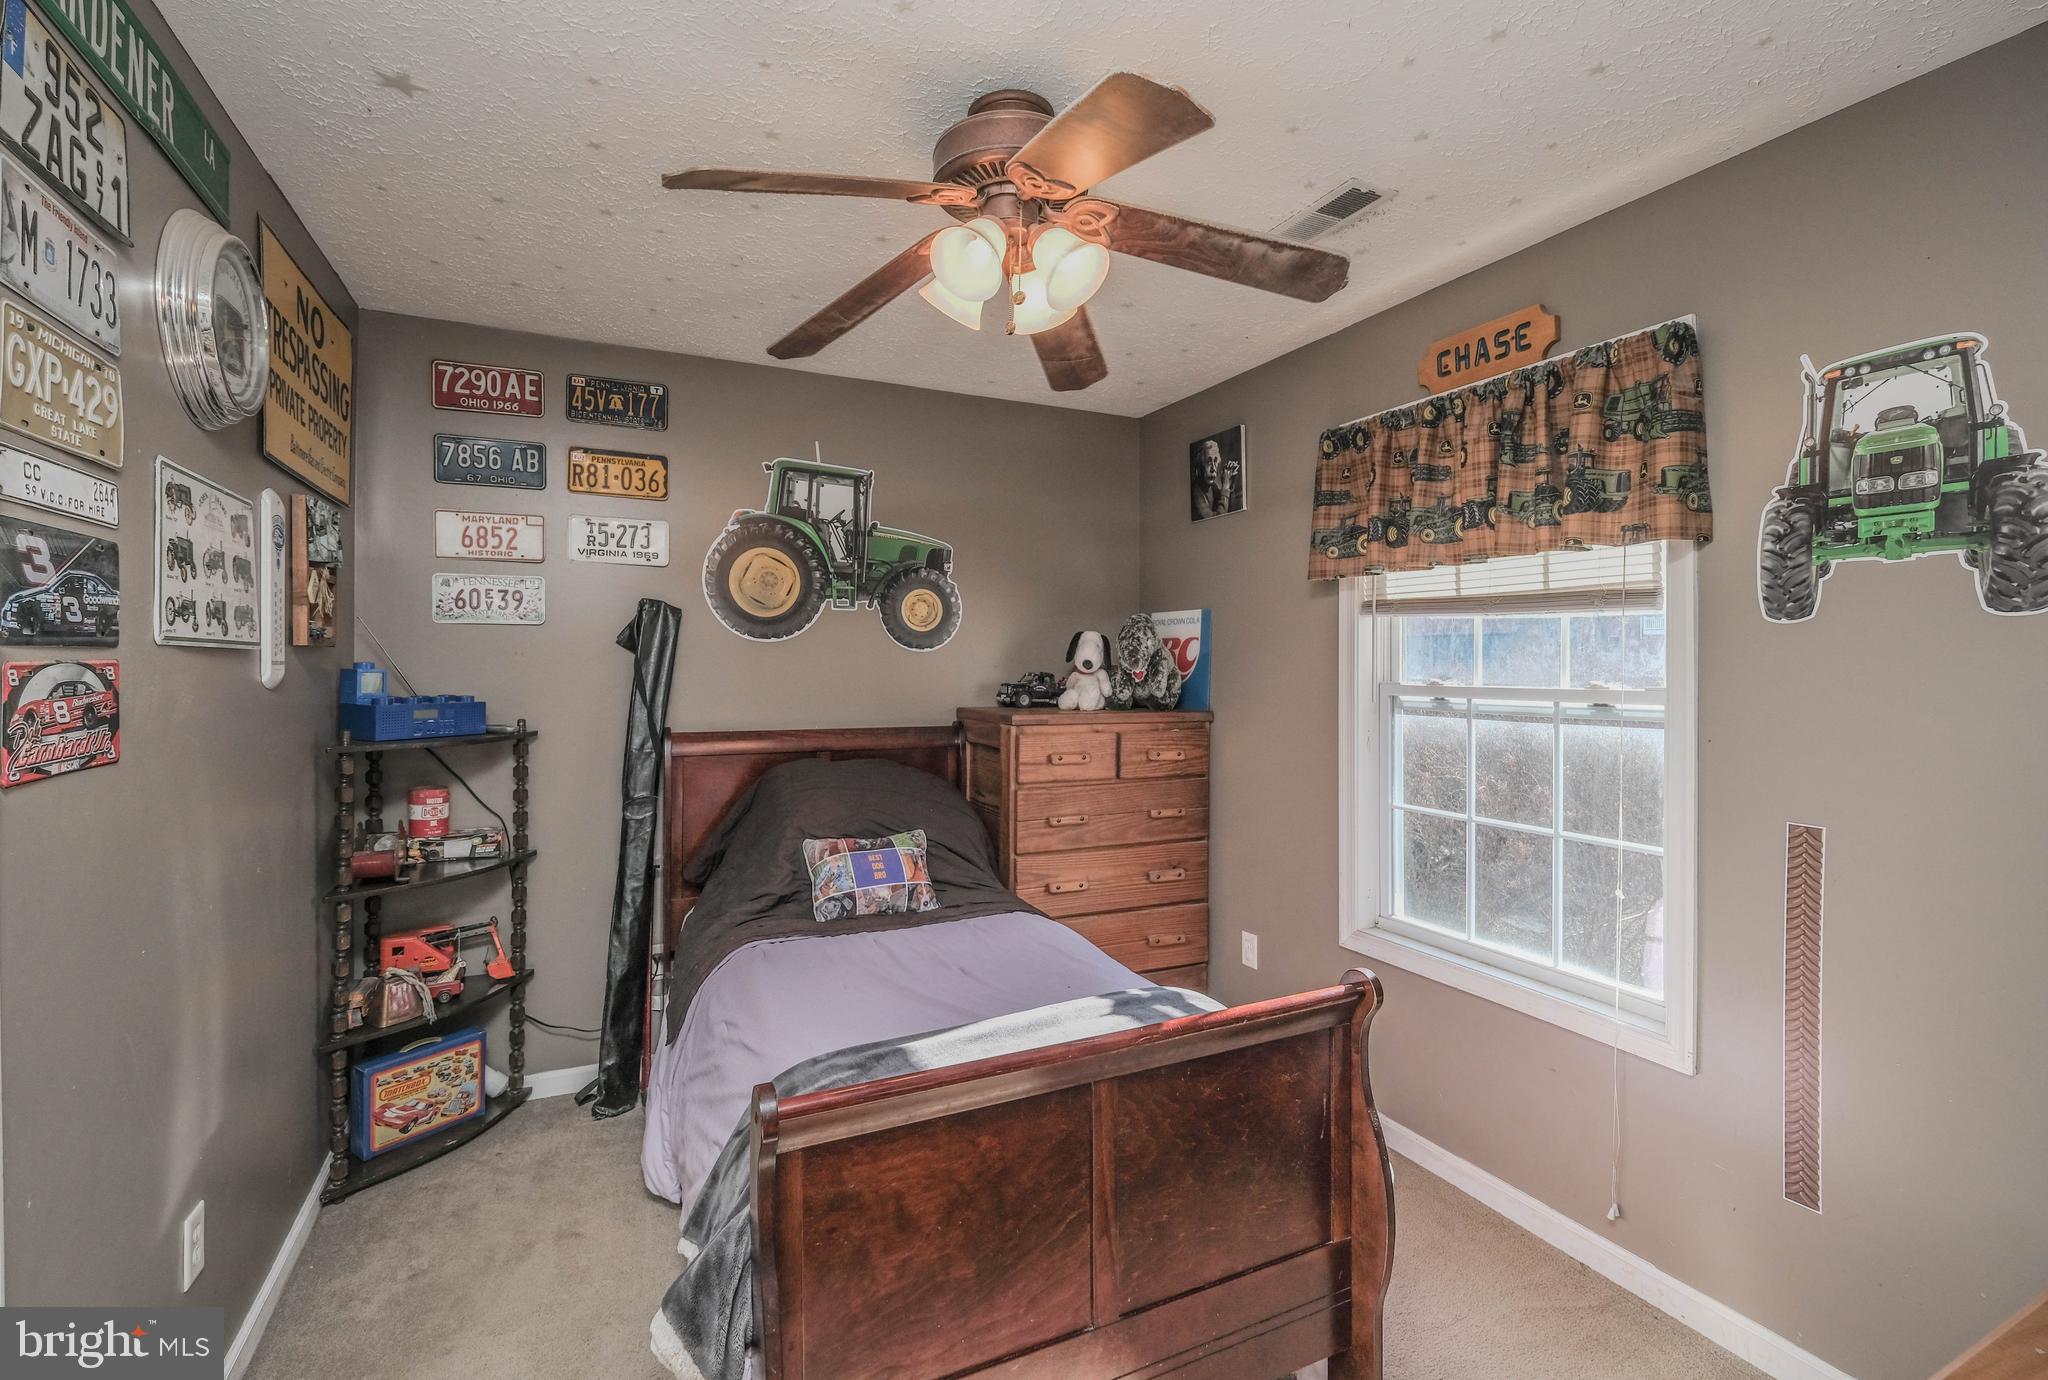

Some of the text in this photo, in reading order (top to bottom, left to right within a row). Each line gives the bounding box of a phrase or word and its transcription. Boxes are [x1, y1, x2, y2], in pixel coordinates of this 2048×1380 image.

[45, 38, 104, 155] 952
[59, 0, 216, 171] DENER LA
[21, 84, 88, 201] ZAG
[41, 194, 52, 212] The
[21, 200, 38, 275] M
[66, 239, 117, 329] 1733
[296, 285, 325, 350] NO
[9, 311, 25, 329] 19
[38, 328, 95, 371] MICHIGAN
[1437, 321, 1532, 377] CHASE
[266, 296, 350, 422] TRESPASSING
[269, 368, 348, 459] PRIVATE PROPERTY
[460, 397, 519, 411] OHIO 1966
[570, 410, 622, 422] BICENTENNIAL
[572, 387, 660, 418] 45V 177
[33, 403, 97, 439] GREAT LAKE
[51, 425, 82, 447] STATE
[441, 441, 539, 473] 7856 AB
[591, 455, 647, 467] PENNSYLVANIA
[23, 461, 115, 508] CC 2644
[467, 474, 516, 484] 67 OHIO
[25, 484, 36, 496] 59
[89, 504, 105, 517] HIRE
[462, 515, 519, 525] MARYLAND
[461, 525, 518, 551] 6852
[16, 533, 56, 587] 3
[577, 547, 659, 560] VIRGINIA 1969
[460, 577, 519, 588] TENNESSEE
[62, 596, 83, 622] 3
[1167, 617, 1185, 626] CROWN
[1186, 616, 1200, 625] COLA
[7, 666, 116, 686] 8 8
[52, 701, 71, 724] 8
[72, 693, 105, 708] Budweiser
[868, 854, 883, 862] BEST
[874, 871, 887, 880] BRO
[383, 1077, 427, 1099] MATCHBOX
